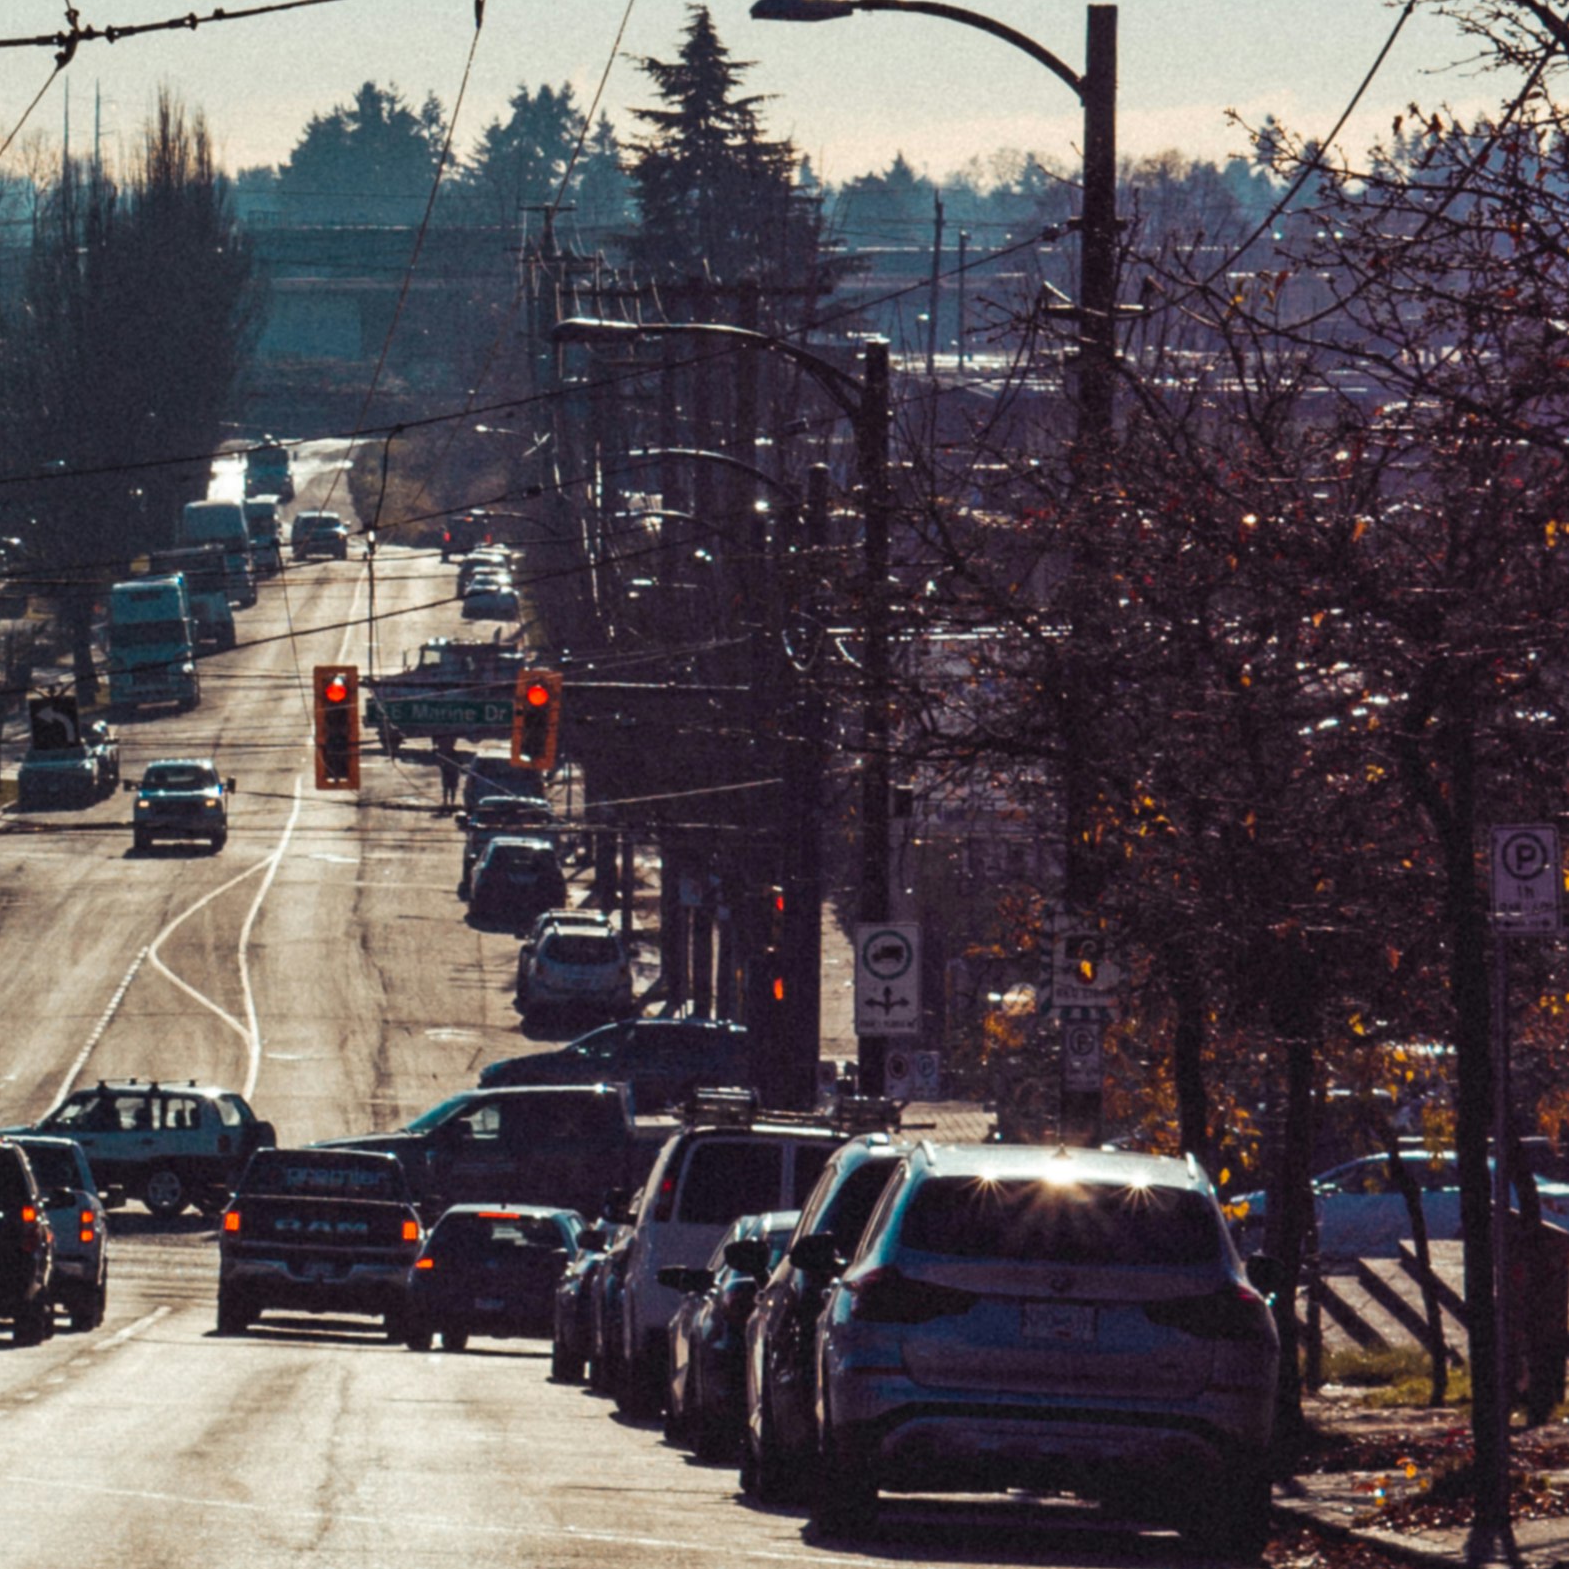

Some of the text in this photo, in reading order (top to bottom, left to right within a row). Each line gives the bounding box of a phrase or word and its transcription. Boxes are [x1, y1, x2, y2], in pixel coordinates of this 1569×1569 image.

[411, 703, 477, 721] Marine
[484, 705, 508, 721] Dr
[1517, 845, 1536, 870] P
[286, 1167, 387, 1187] premier
[275, 1219, 368, 1234] RAM
